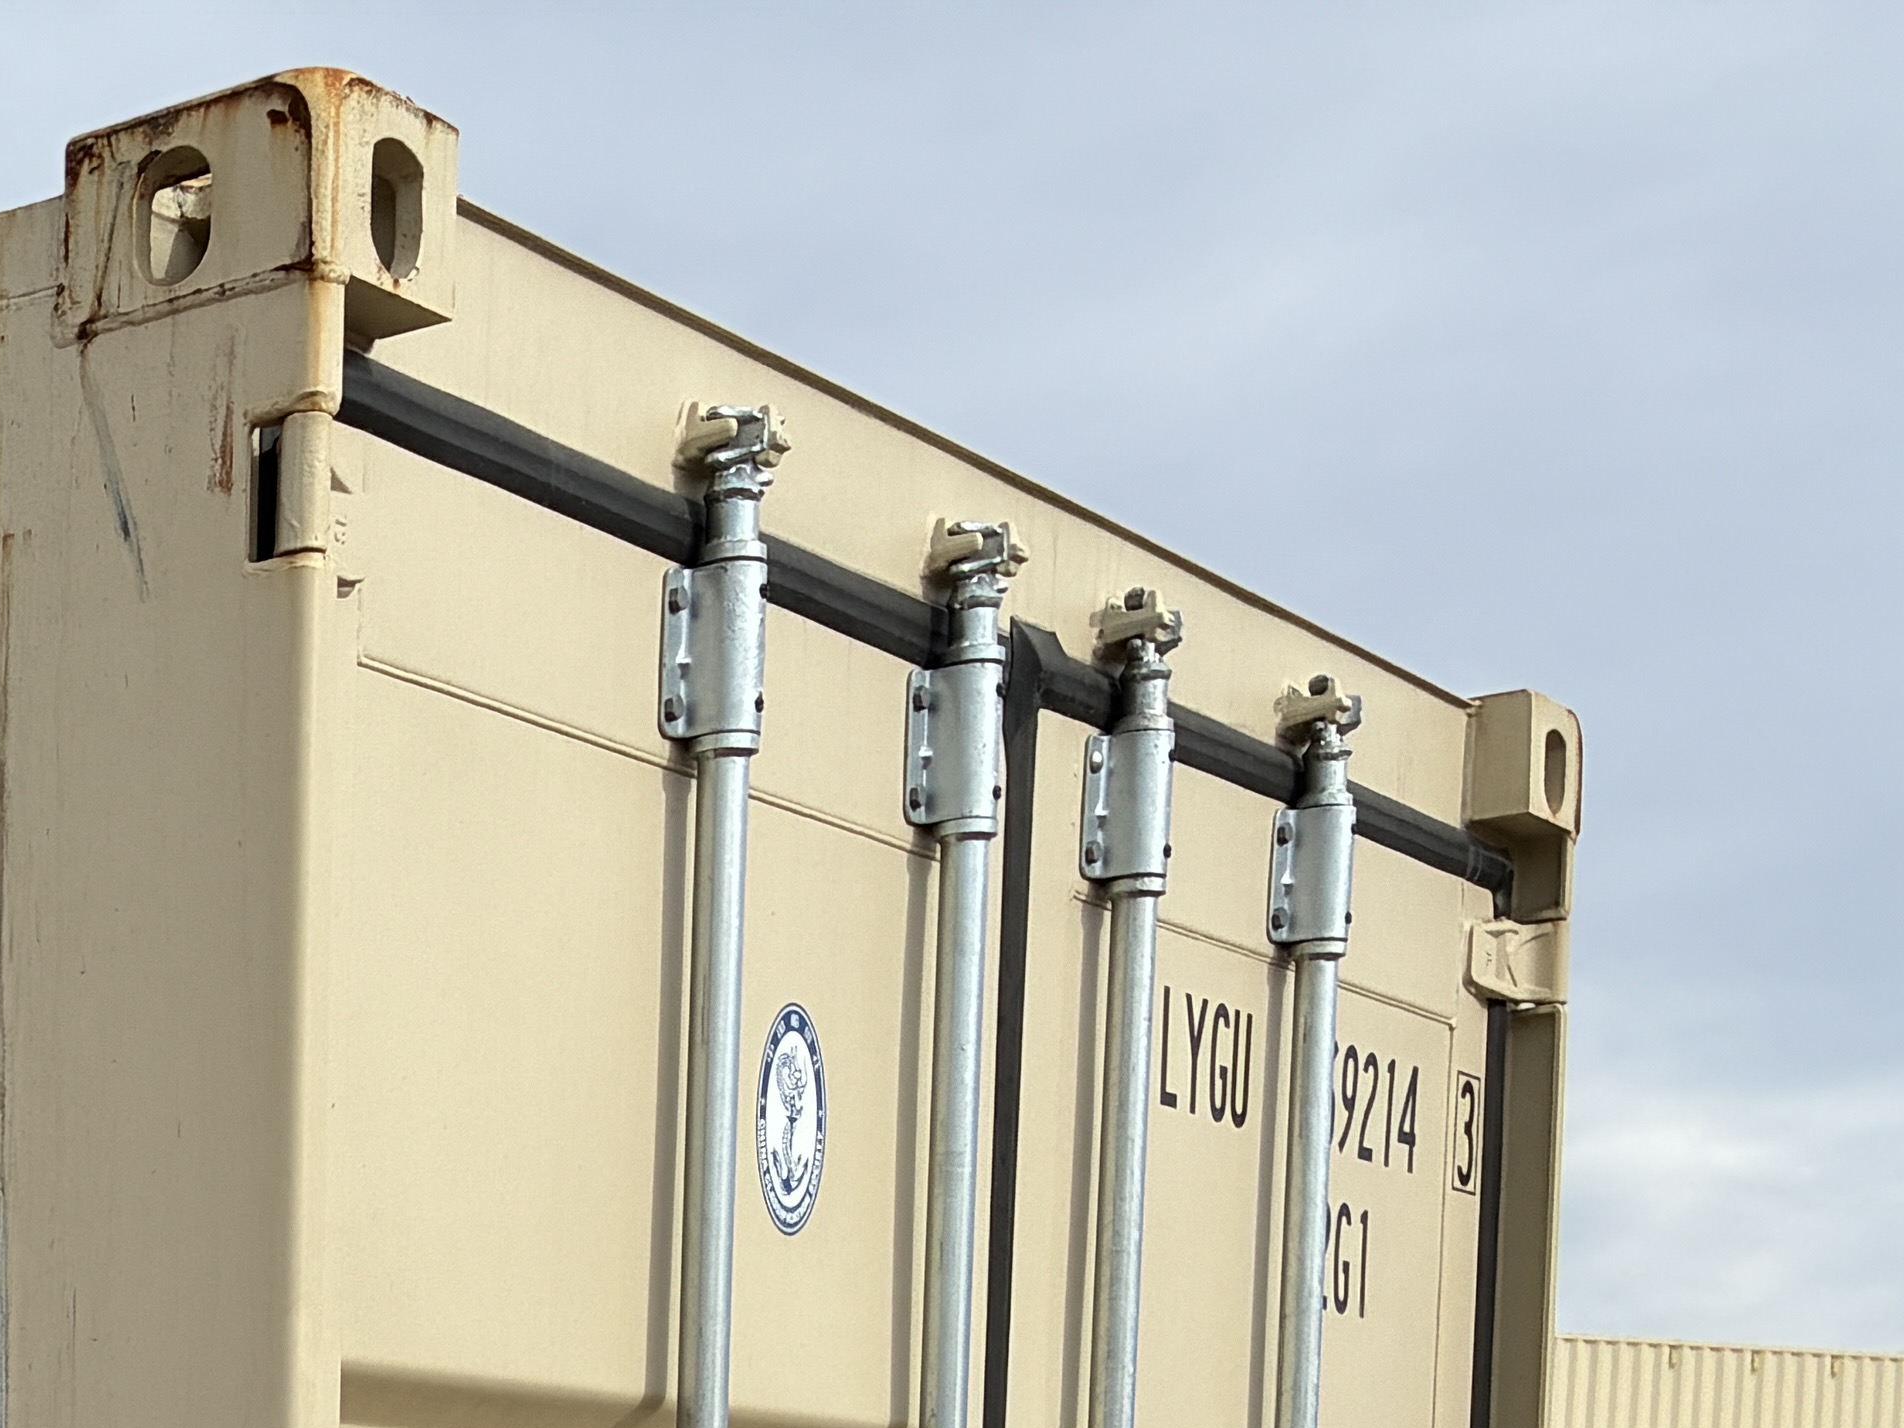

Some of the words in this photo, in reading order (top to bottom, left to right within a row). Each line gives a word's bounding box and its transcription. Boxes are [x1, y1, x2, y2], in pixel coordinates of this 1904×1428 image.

[1159, 985, 1254, 1129] LYGU
[1330, 1040, 1419, 1174] 9214
[1456, 1079, 1476, 1187] 3
